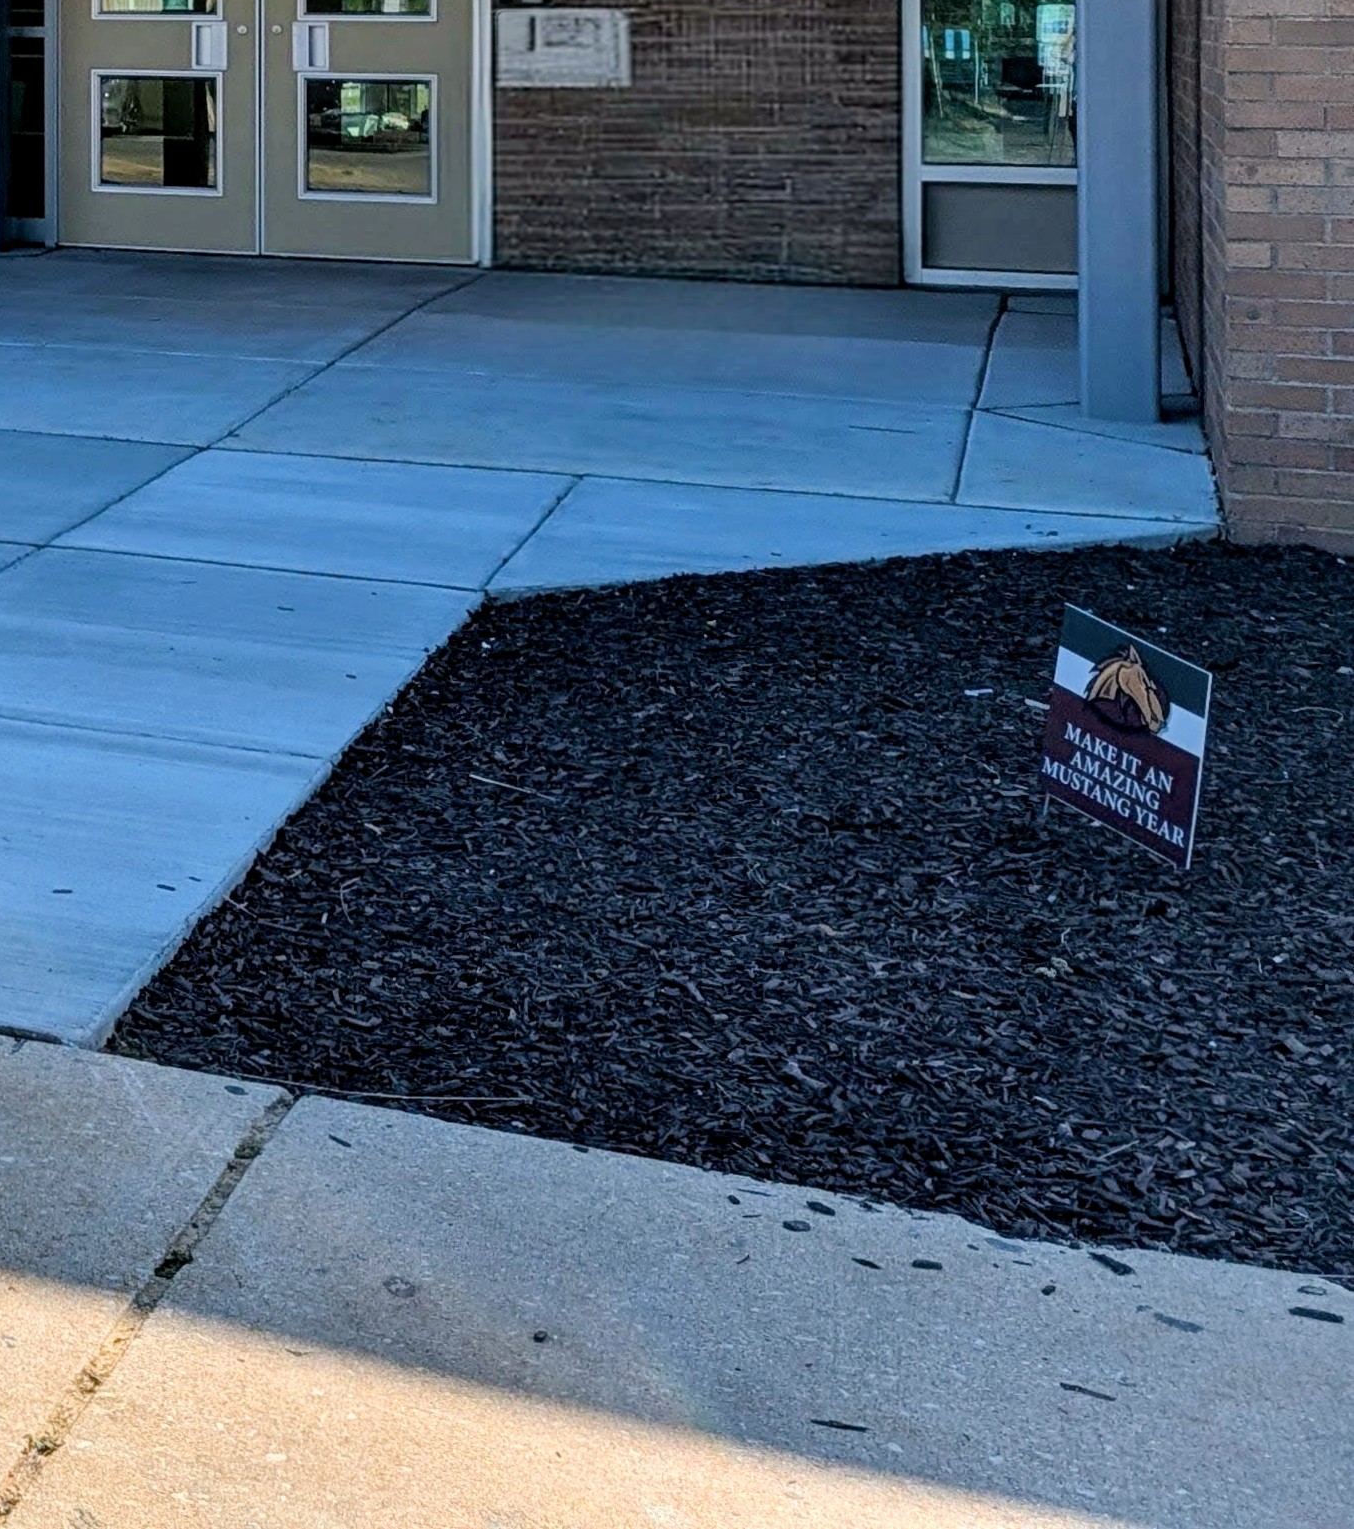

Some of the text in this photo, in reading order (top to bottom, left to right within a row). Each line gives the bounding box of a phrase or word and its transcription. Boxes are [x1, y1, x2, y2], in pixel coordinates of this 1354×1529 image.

[1063, 722, 1173, 794] MAKE IT AN
[1069, 750, 1161, 811] AMAZING
[1041, 756, 1185, 848] MUSTANG YEAR
